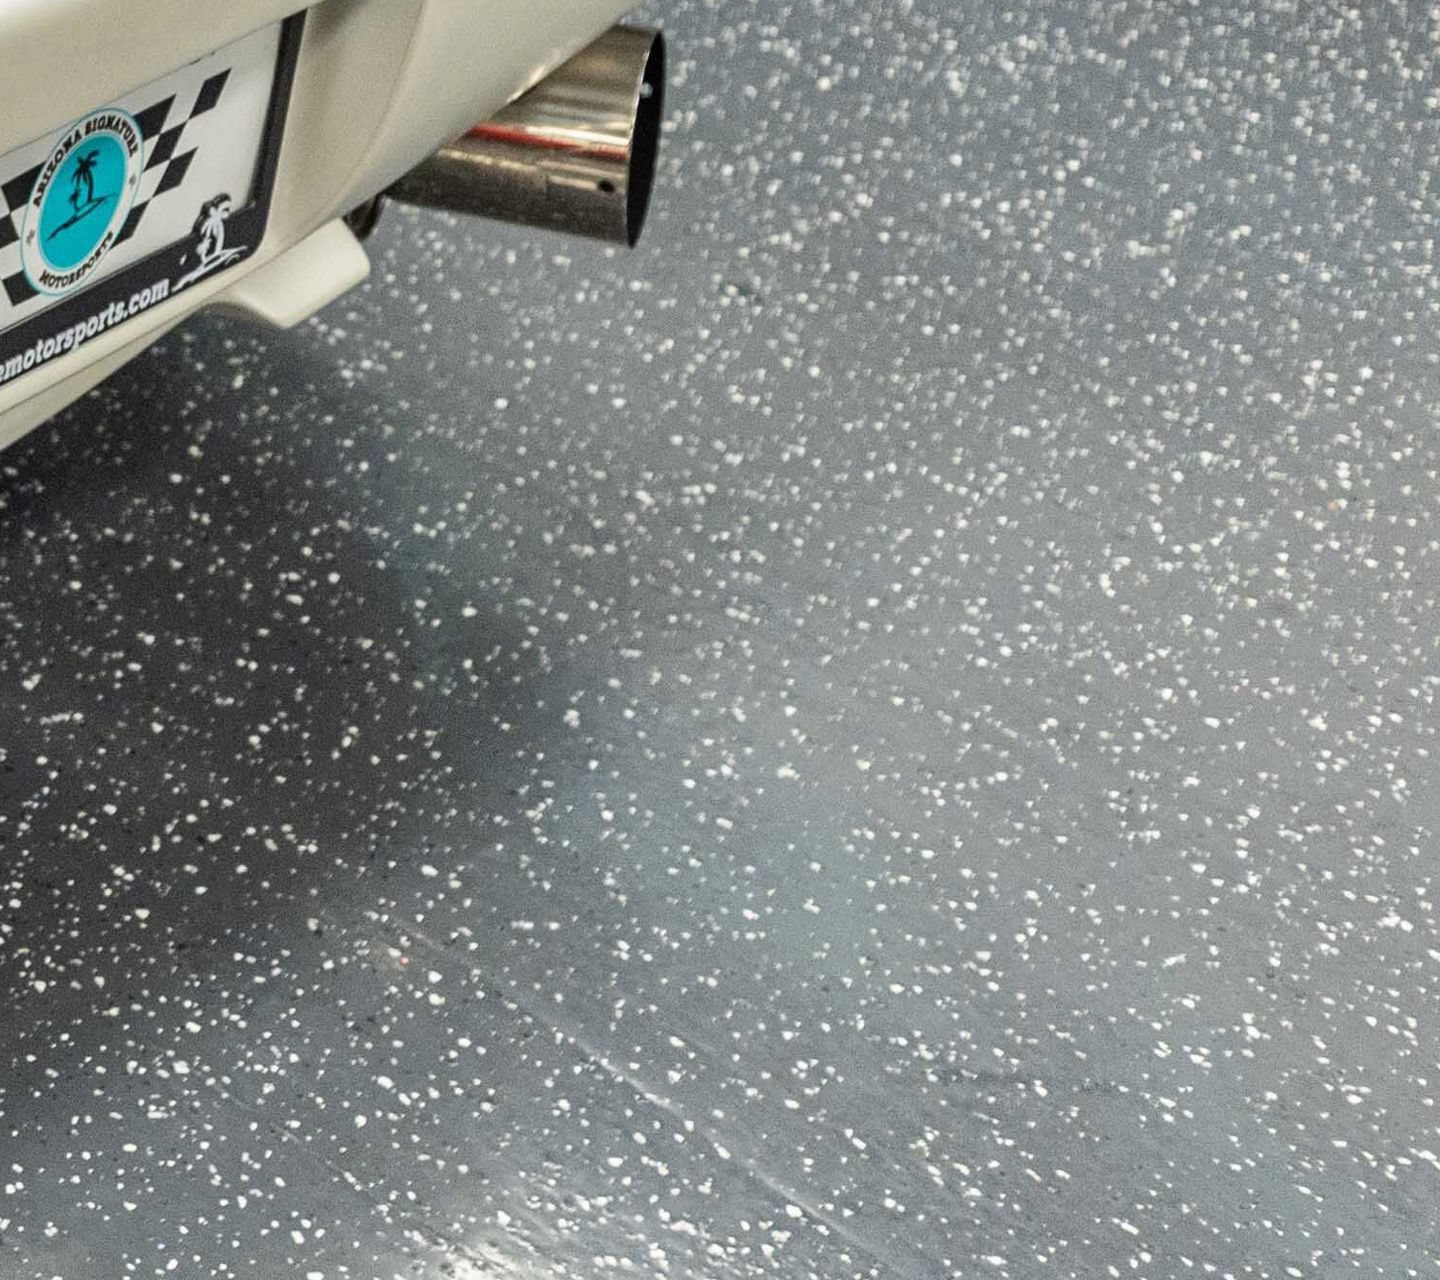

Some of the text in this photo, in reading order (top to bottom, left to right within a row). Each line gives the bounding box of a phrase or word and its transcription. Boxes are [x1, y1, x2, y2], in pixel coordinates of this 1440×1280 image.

[33, 113, 140, 208] ARIZONA SIGNATURE
[39, 230, 114, 288] MOTORSPORTS
